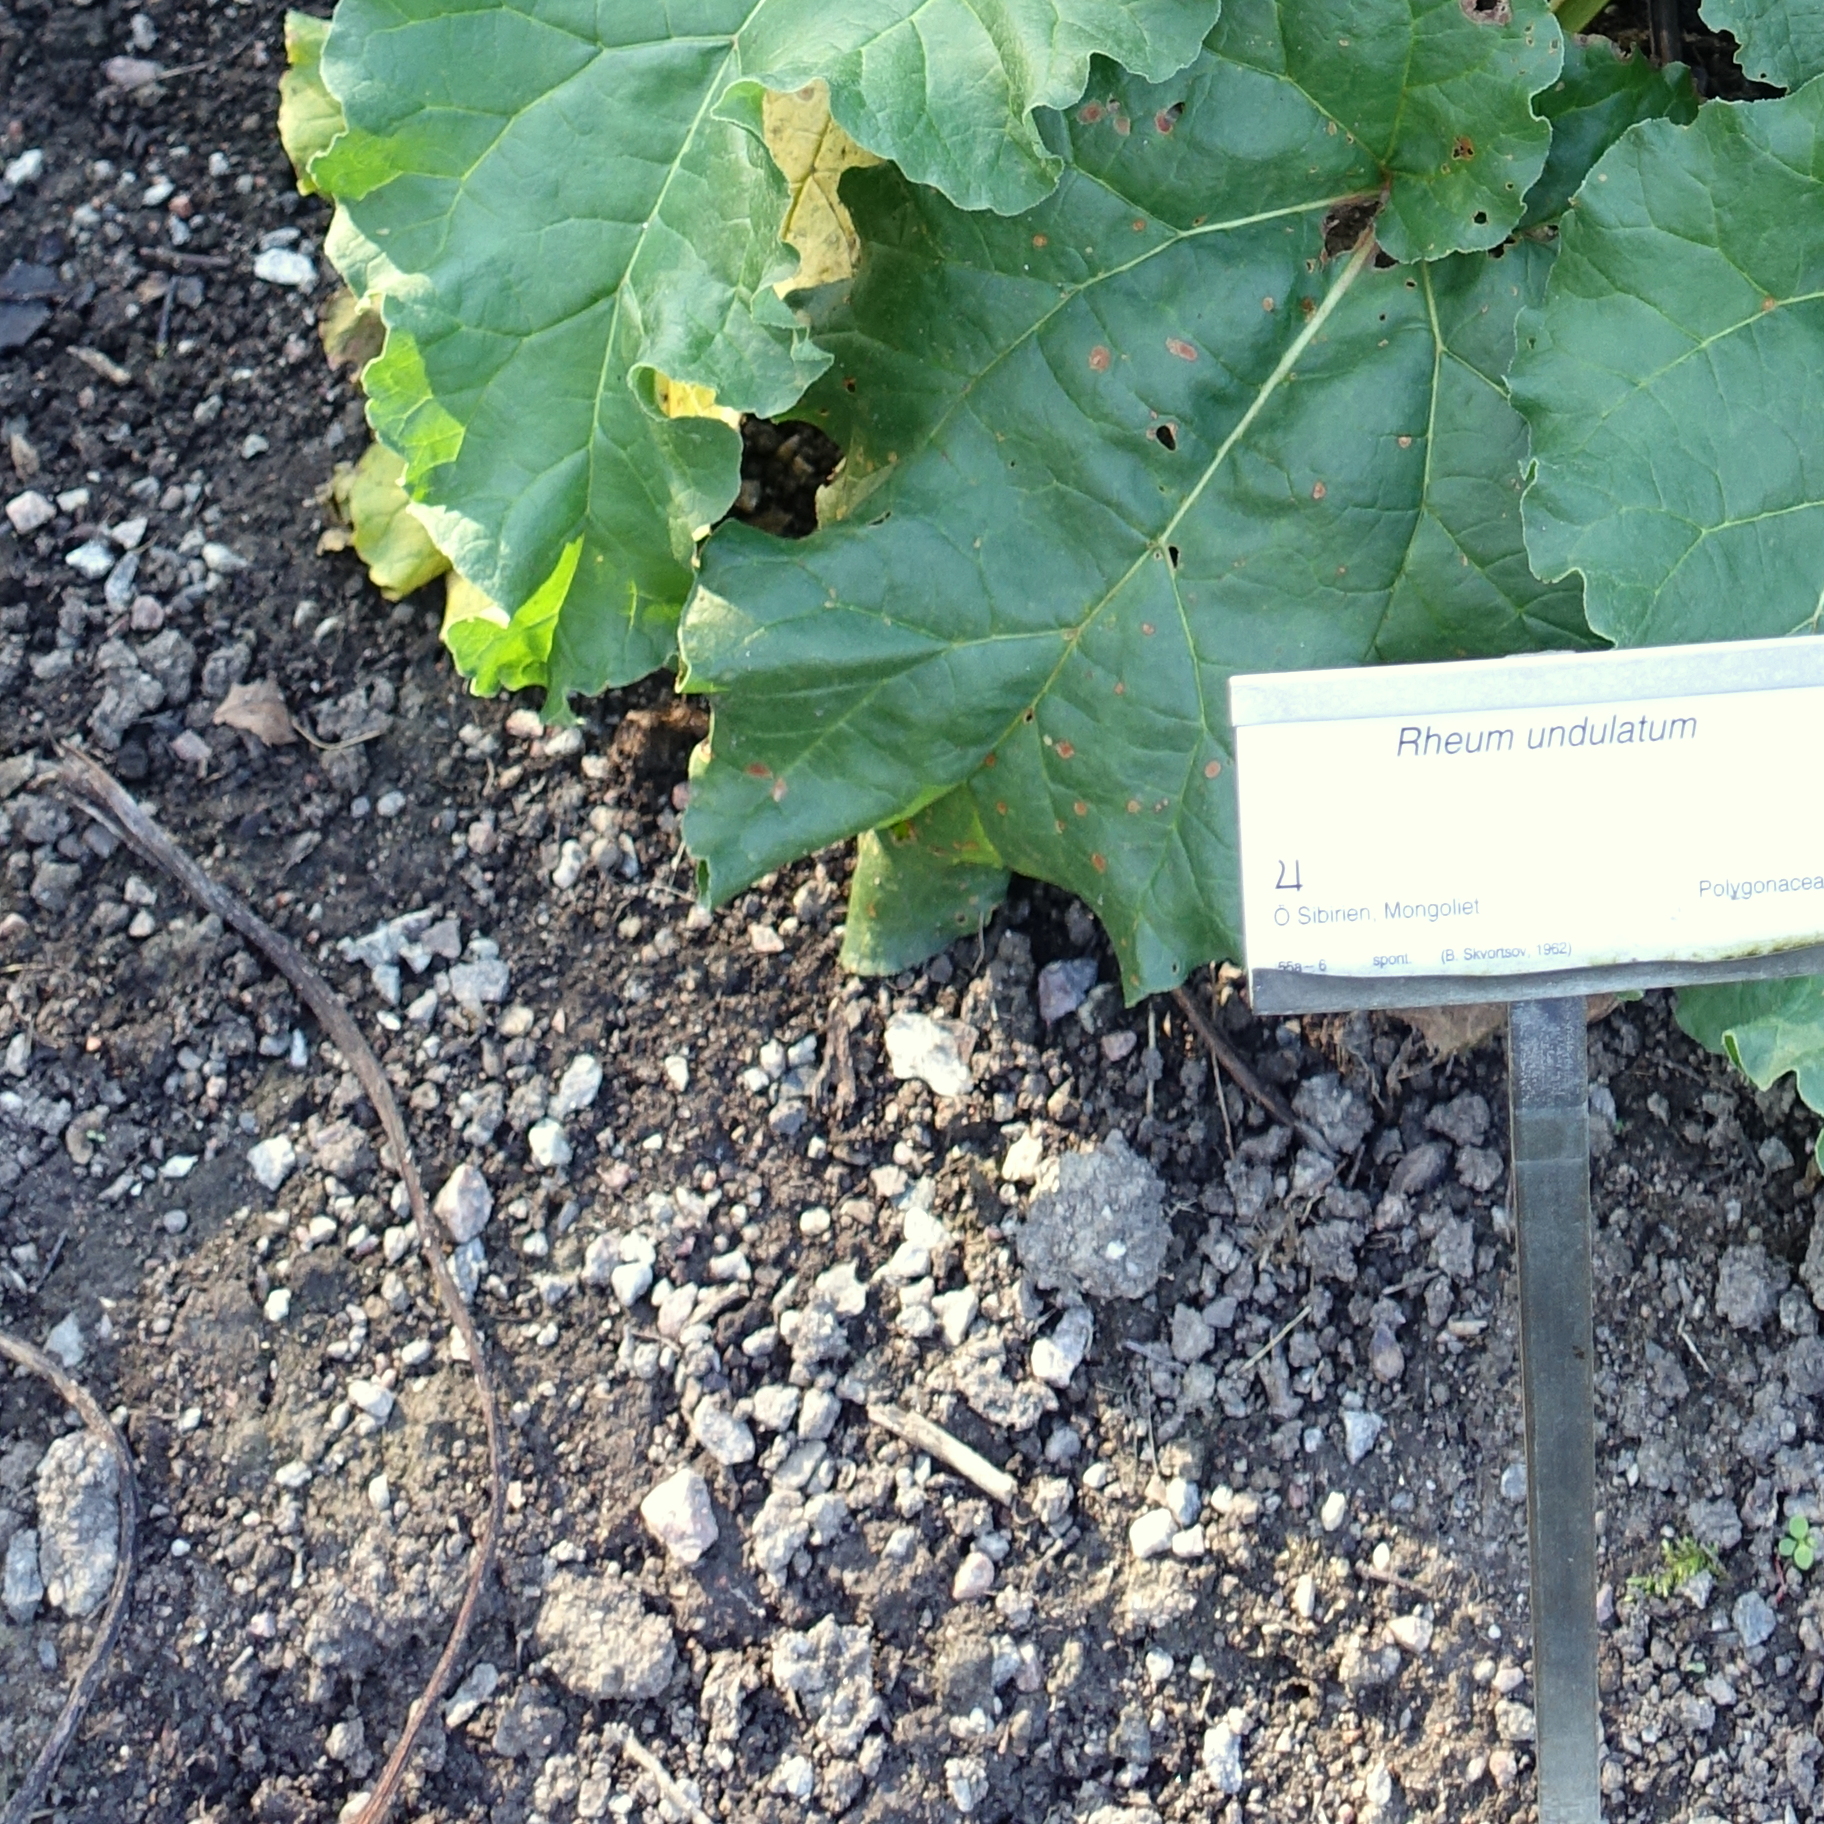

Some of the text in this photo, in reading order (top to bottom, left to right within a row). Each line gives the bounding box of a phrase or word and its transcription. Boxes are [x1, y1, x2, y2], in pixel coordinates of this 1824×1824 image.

[1397, 714, 1698, 757] Rheum undulatum
[1385, 898, 1480, 922] Mongoliet
[1536, 941, 1572, 957] 1962)
